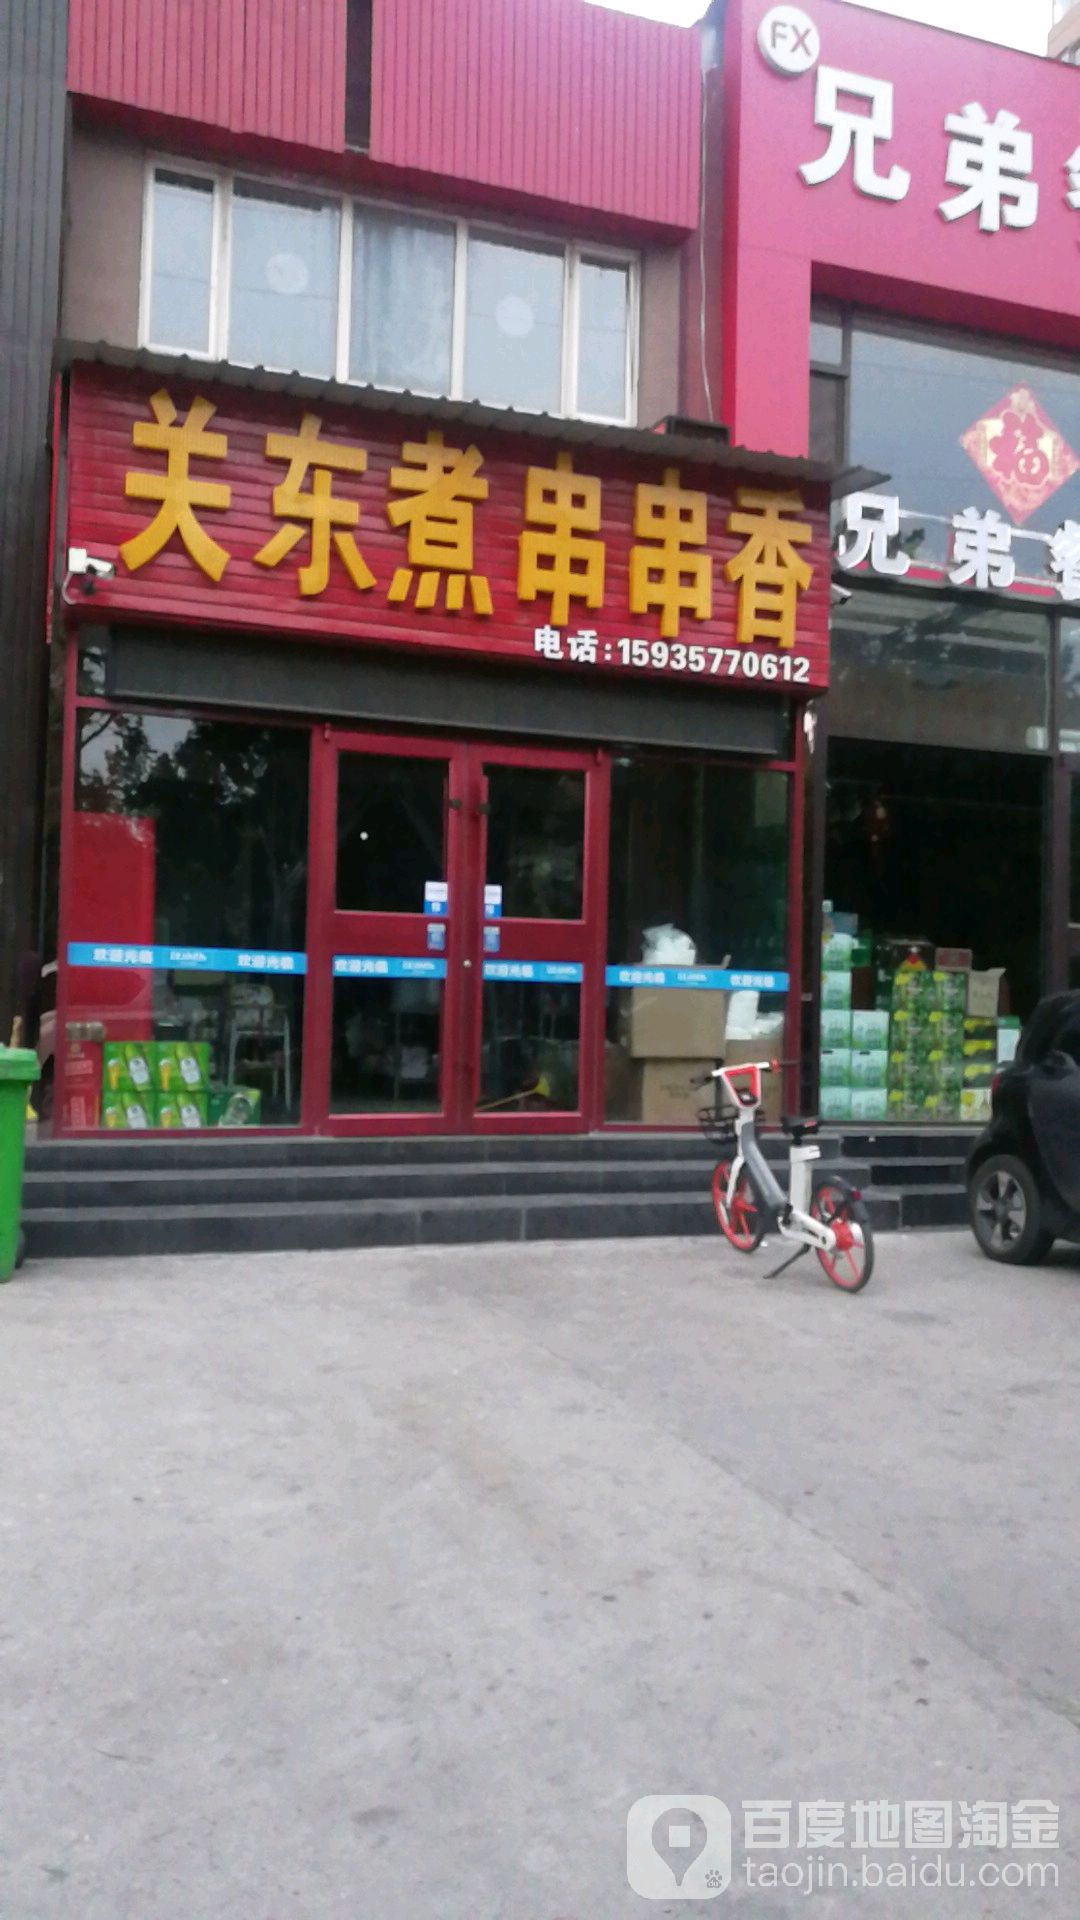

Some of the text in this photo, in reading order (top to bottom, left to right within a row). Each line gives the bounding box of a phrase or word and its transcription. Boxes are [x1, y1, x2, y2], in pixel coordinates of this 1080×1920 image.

[770, 20, 813, 57] FX
[797, 64, 1080, 233] 兄弟
[119, 387, 814, 650] 关东煮串串香
